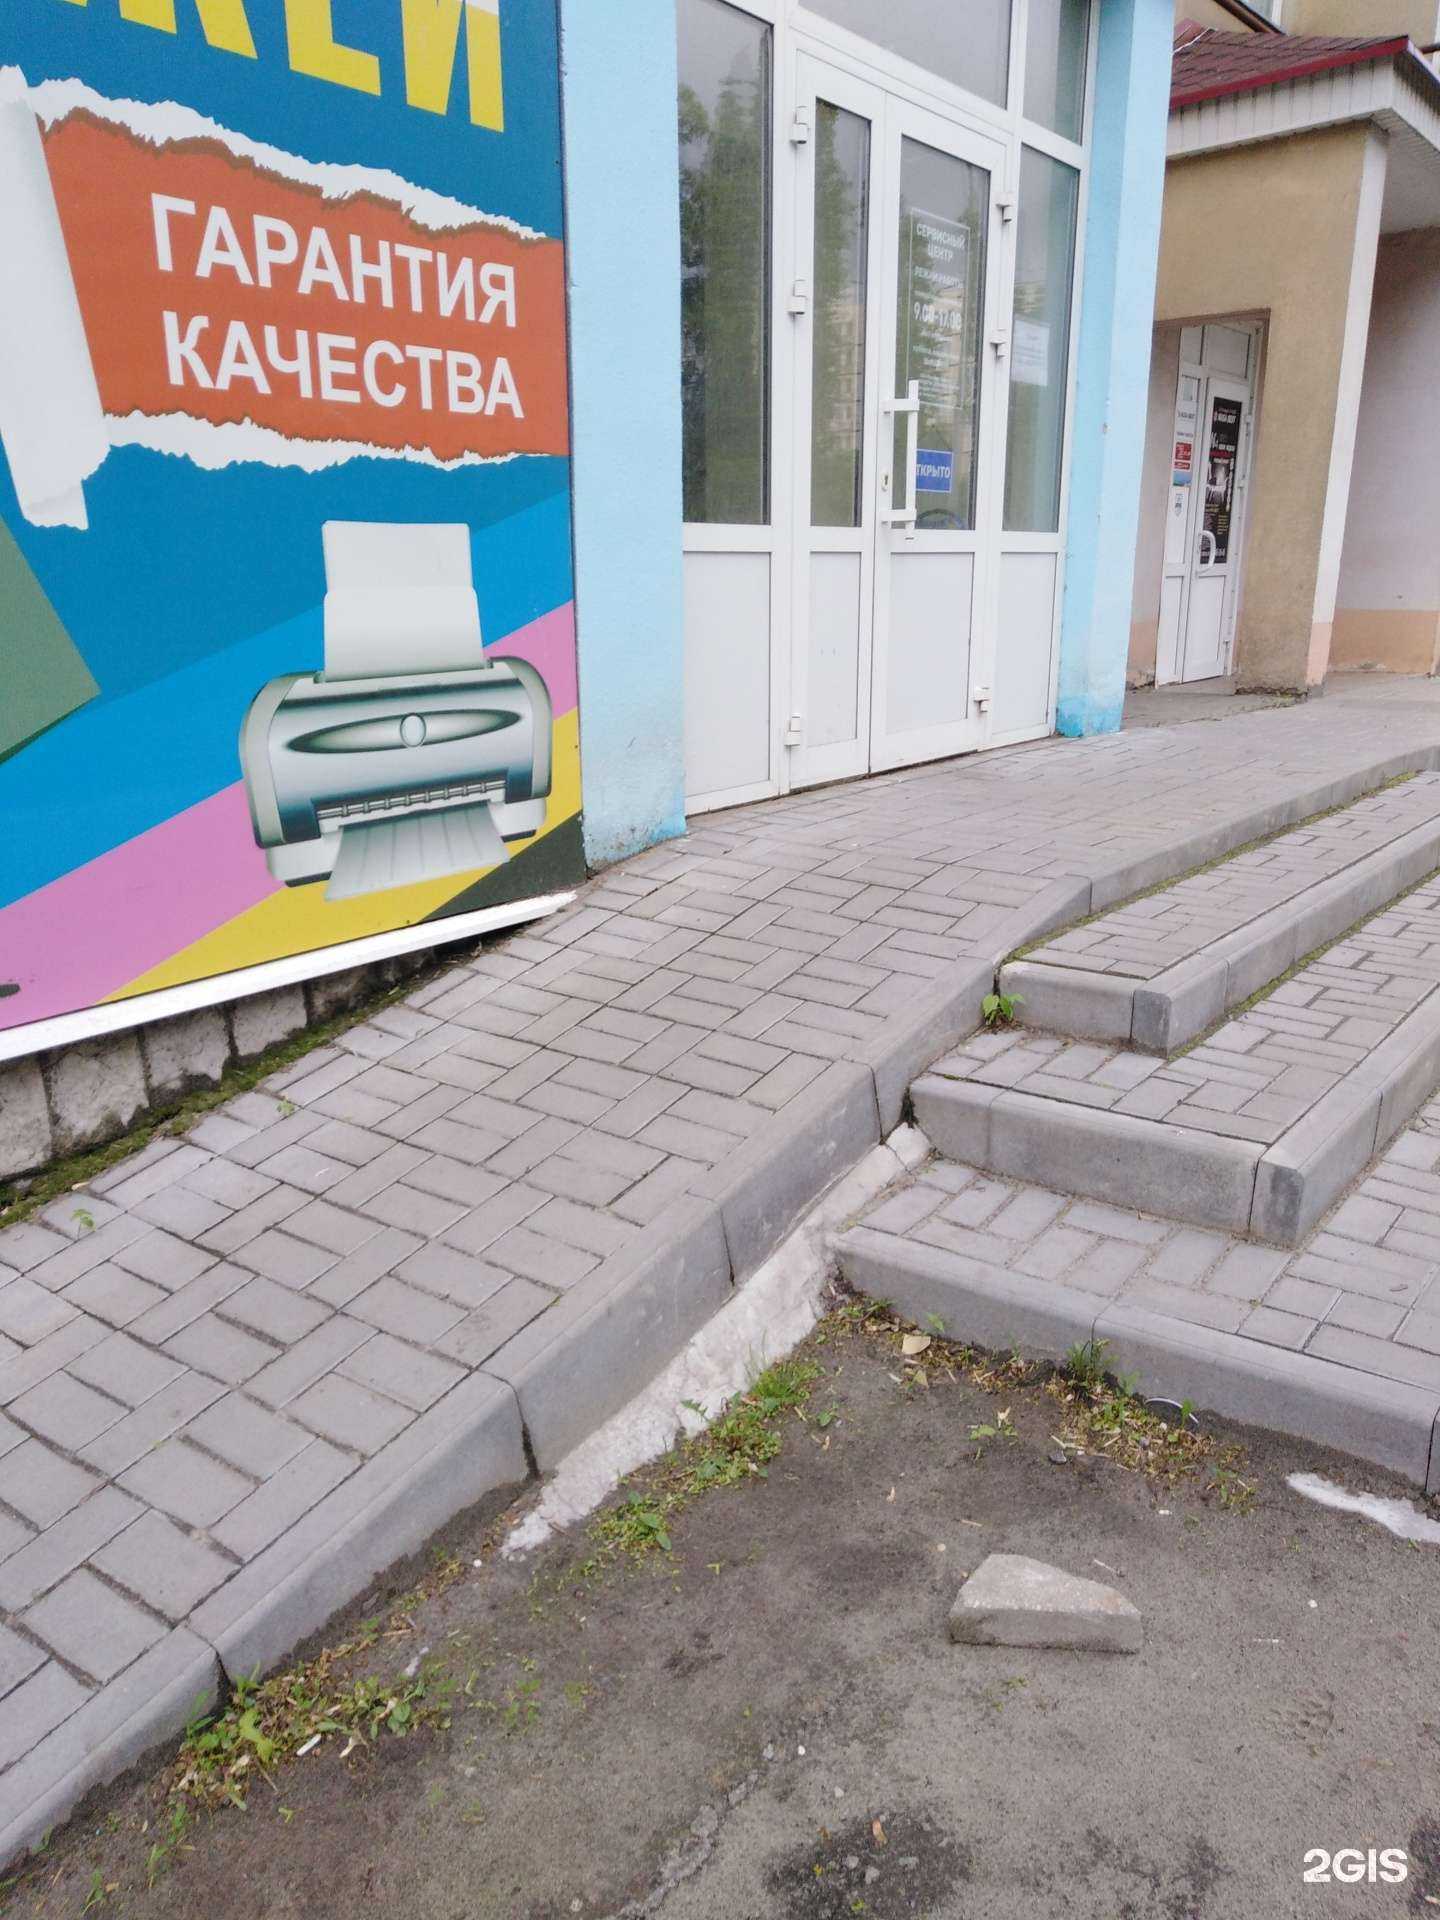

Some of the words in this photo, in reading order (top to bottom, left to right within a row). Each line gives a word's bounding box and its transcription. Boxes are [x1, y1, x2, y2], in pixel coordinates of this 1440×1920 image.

[916, 223, 966, 249] СЕРВИСНЫЙ
[151, 192, 517, 328] ГАРАНТИЯ
[928, 245, 954, 263] ЦЕНТР
[162, 310, 524, 418] КАЧЕСТВА
[915, 463, 951, 479] ТКРЫТО
